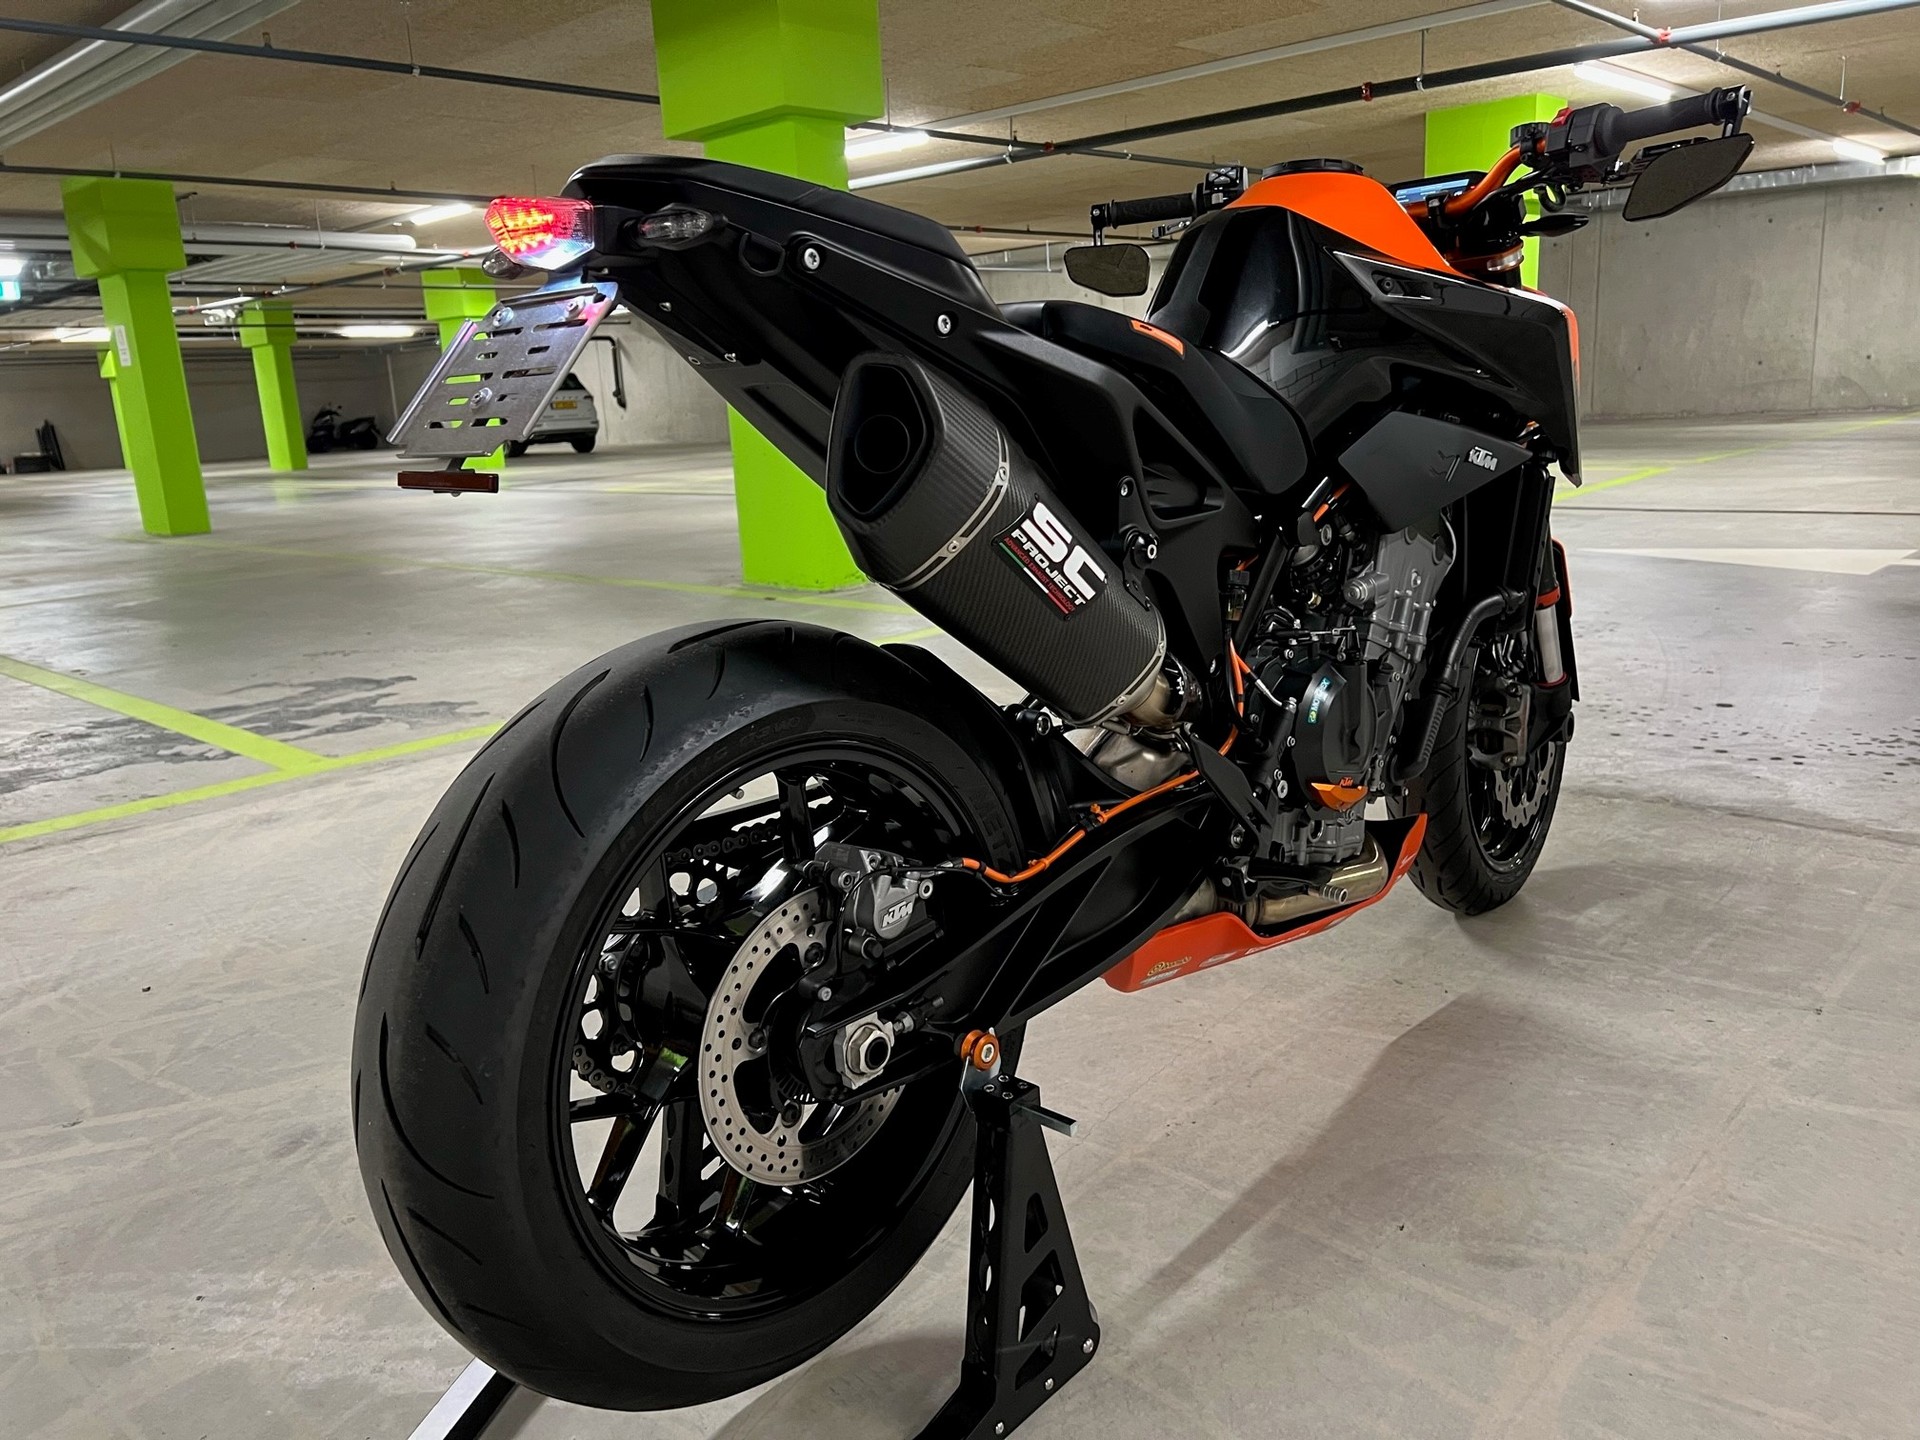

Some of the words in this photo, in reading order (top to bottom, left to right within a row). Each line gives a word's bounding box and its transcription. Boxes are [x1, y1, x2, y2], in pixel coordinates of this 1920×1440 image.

[1468, 446, 1498, 471] KTM
[1011, 528, 1087, 606] PROJECT
[1020, 502, 1106, 600] SC
[882, 900, 914, 928] KTM
